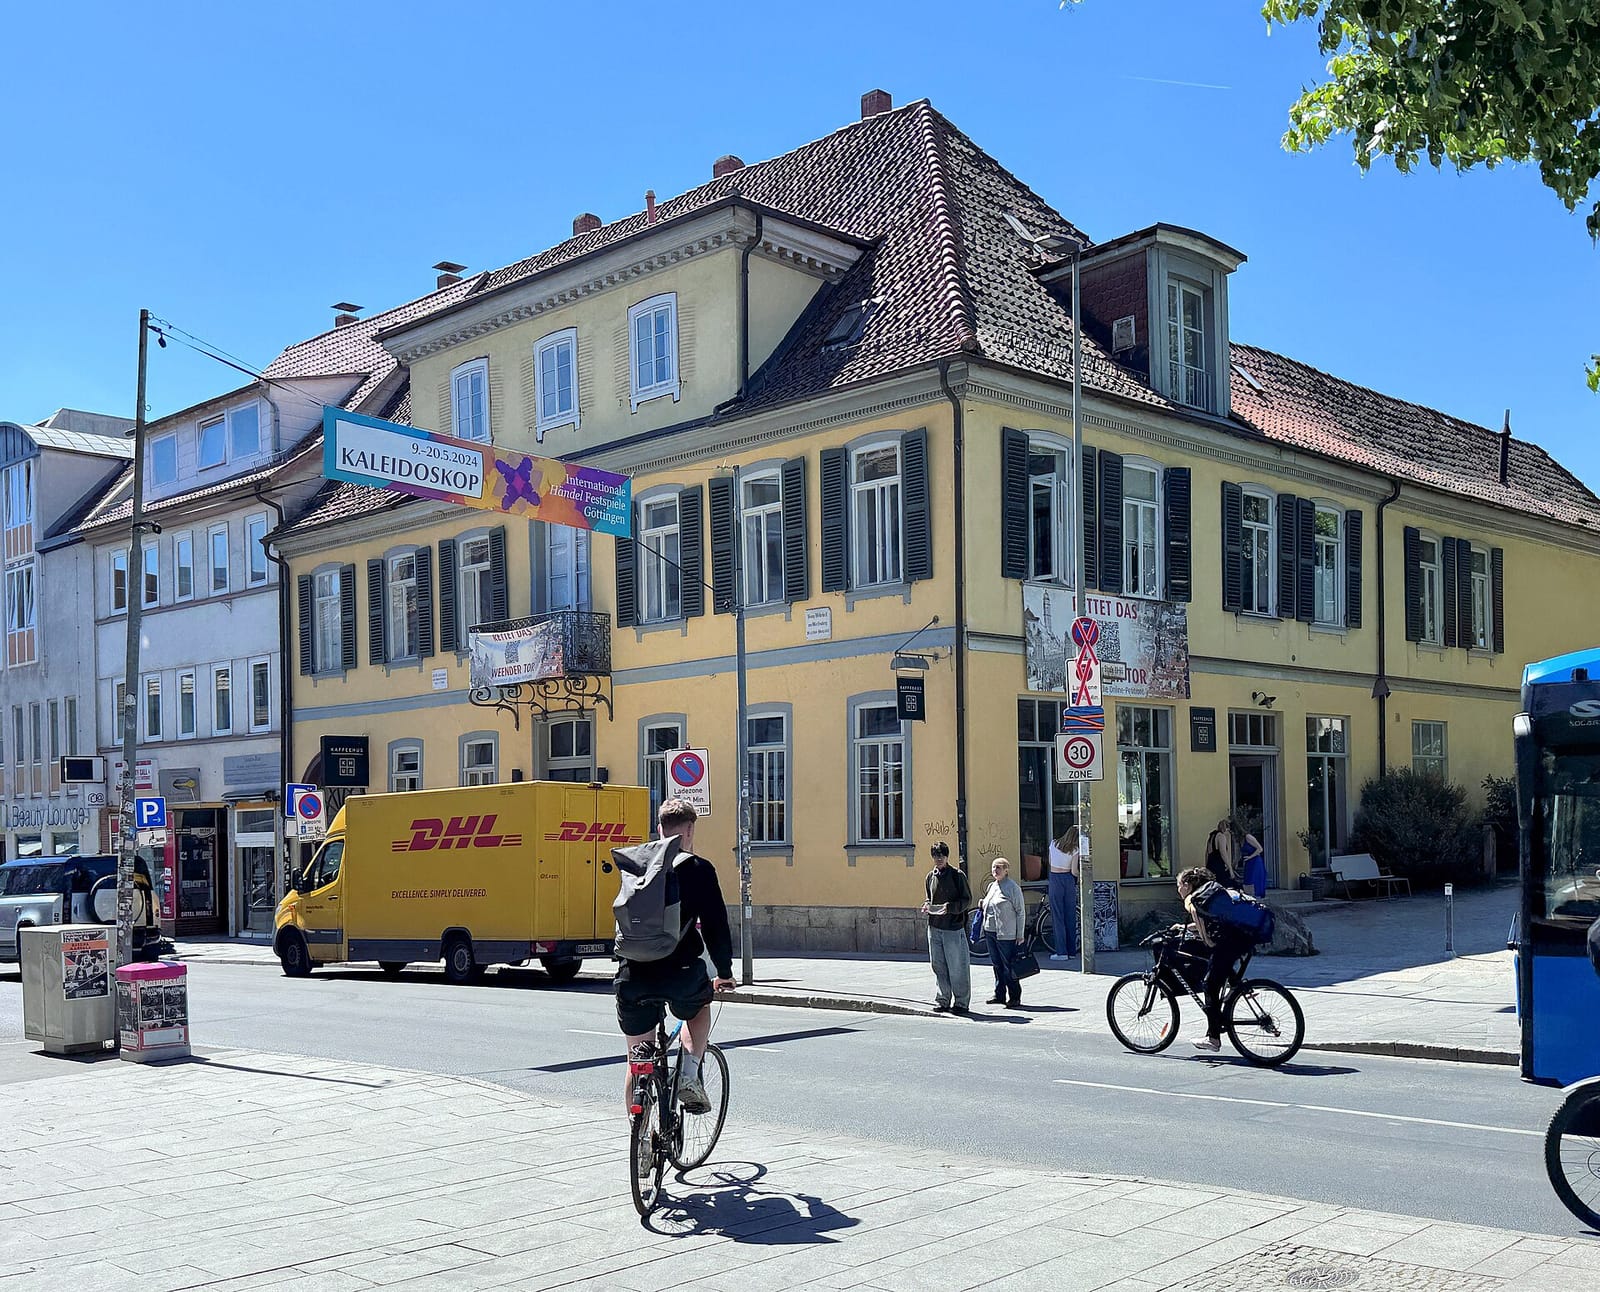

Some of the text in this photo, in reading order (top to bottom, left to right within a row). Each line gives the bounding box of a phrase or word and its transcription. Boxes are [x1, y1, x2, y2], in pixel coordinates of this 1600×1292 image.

[341, 447, 479, 491] KALEIDOSKOP
[565, 473, 626, 497] Internationale
[549, 484, 626, 512] Händel Festspiele
[583, 506, 625, 525] Göttingen
[1072, 596, 1138, 620] TTET DAS
[491, 663, 535, 677] WEENDER TOR
[1126, 668, 1148, 685] TOR
[1070, 745, 1089, 760] 30
[1068, 770, 1093, 779] ZONE
[673, 787, 703, 795] Ladezone
[12, 805, 45, 831] Beauty
[47, 803, 85, 830] Lounge
[142, 801, 159, 824] P
[408, 814, 504, 851] DHL
[559, 821, 630, 844] DHL
[391, 888, 488, 899] EXCELLENCE. SIMPLY DELIVERED.
